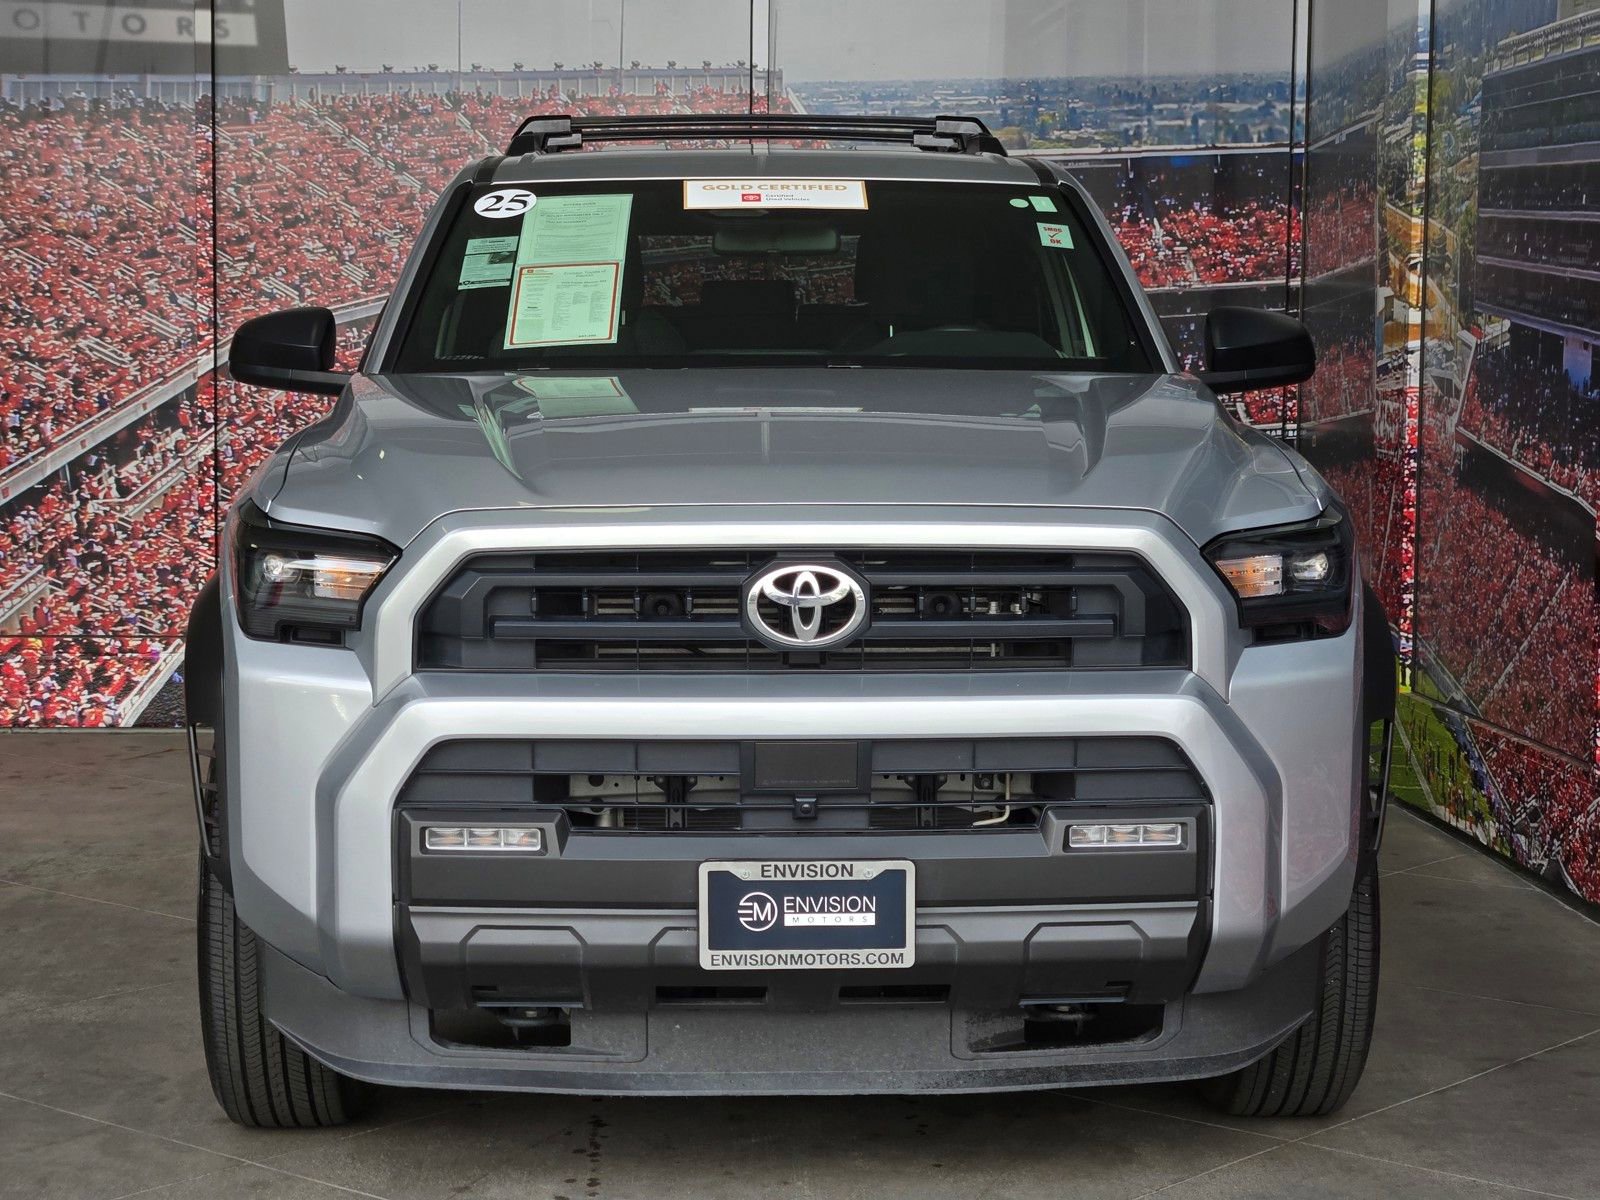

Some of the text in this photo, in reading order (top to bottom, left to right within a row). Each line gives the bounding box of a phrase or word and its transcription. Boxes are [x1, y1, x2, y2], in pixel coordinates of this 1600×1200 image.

[480, 194, 532, 212] 25
[760, 863, 854, 879] ENVISION
[783, 895, 876, 913] ENVISION
[792, 915, 868, 923] MOTORS
[710, 952, 904, 966] ENVISIONMOTORS.COM
